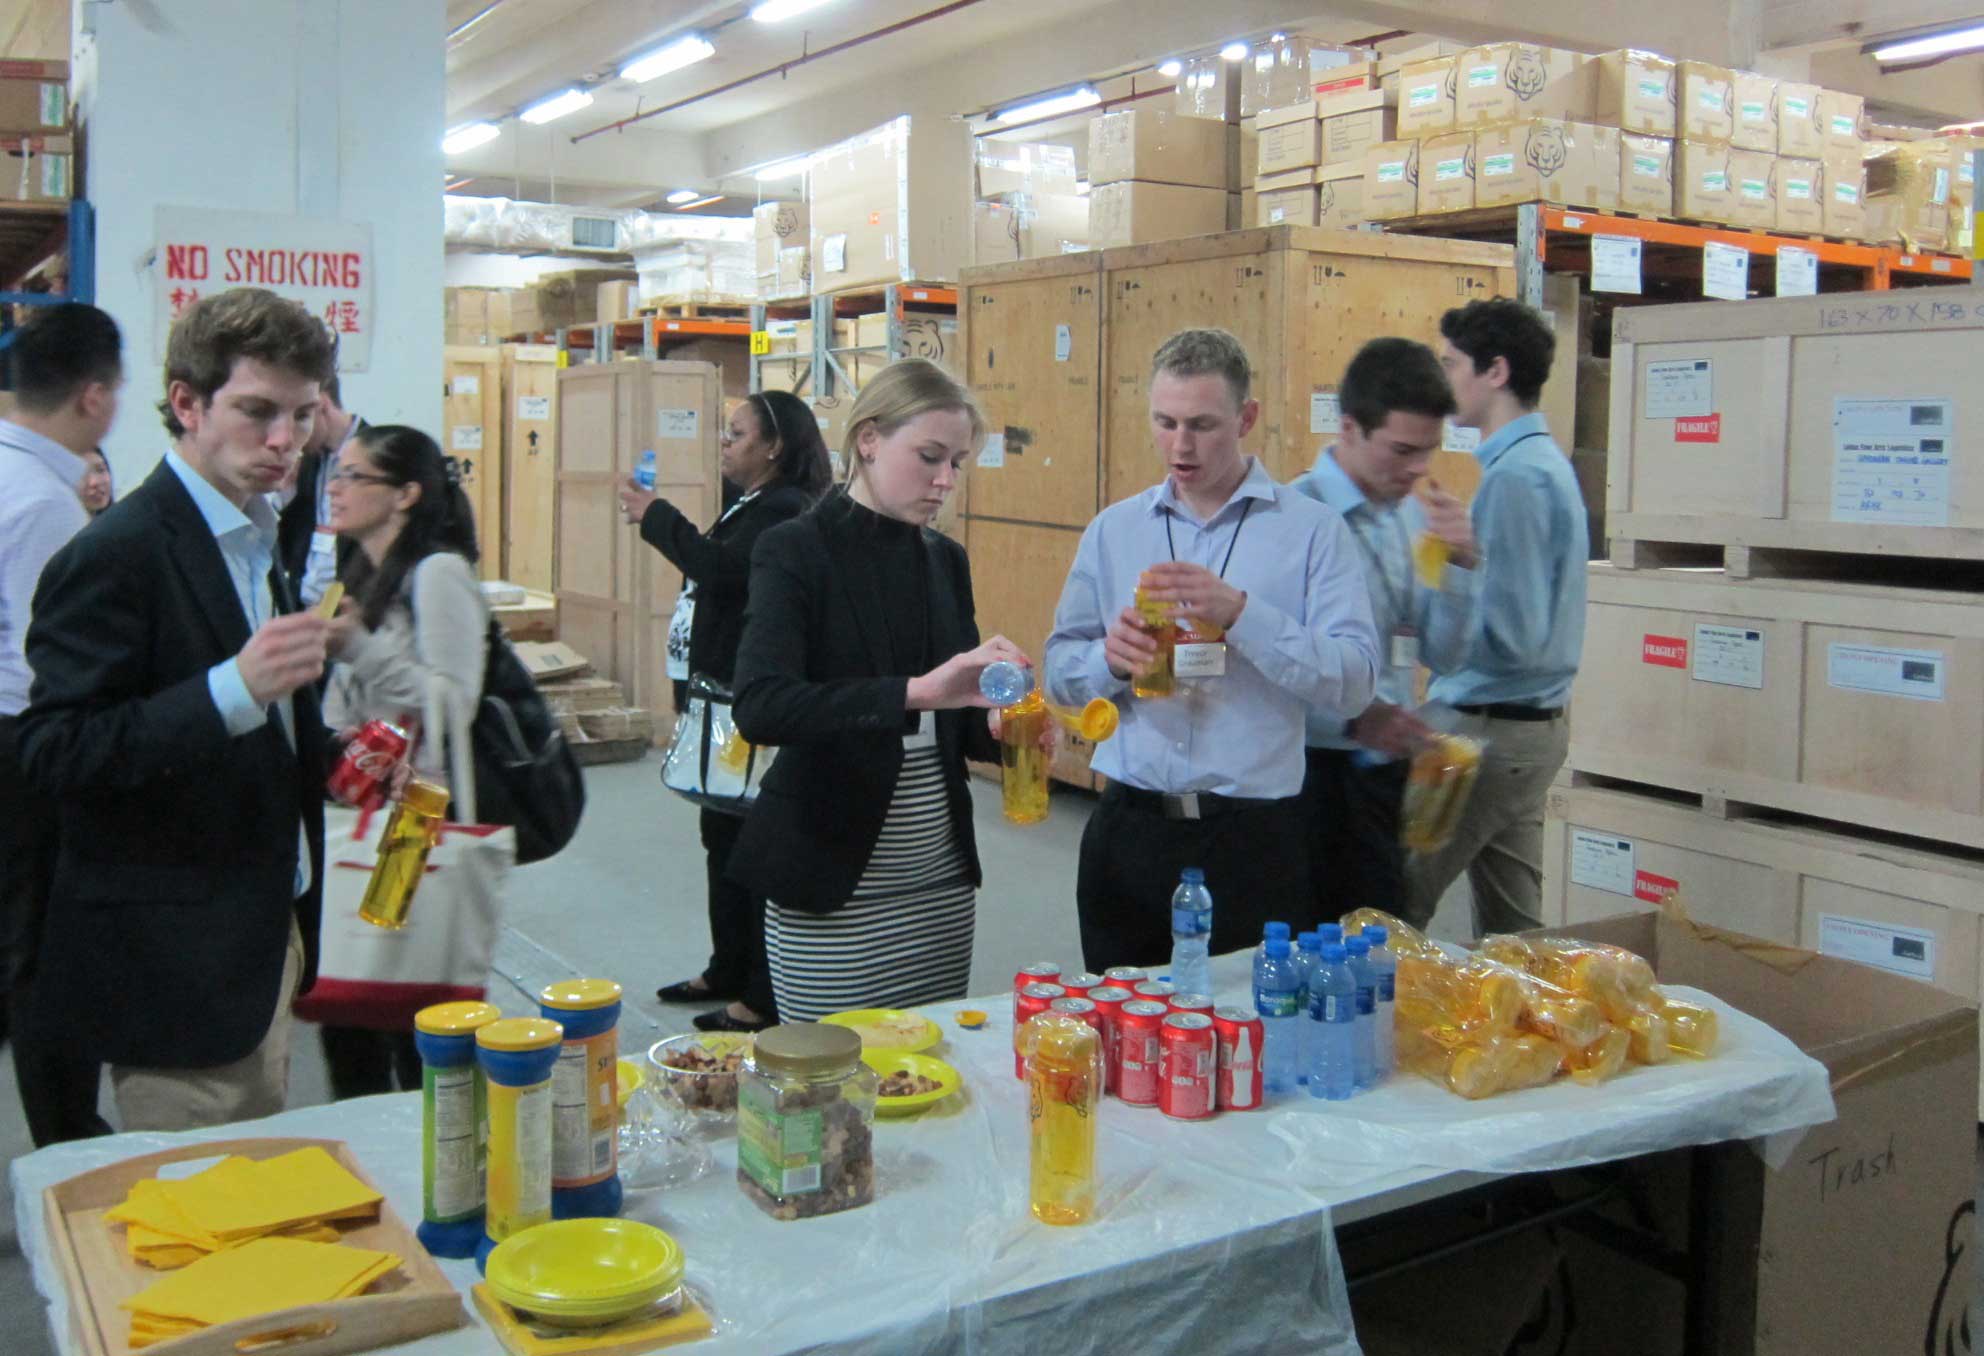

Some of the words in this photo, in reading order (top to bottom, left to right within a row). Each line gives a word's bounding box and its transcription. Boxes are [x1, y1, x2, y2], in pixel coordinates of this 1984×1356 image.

[167, 245, 208, 280] NO
[225, 248, 361, 288] SMOKING
[755, 334, 764, 352] H
[1645, 643, 1677, 658] FRAGILE
[1808, 1132, 1897, 1204] Trash
